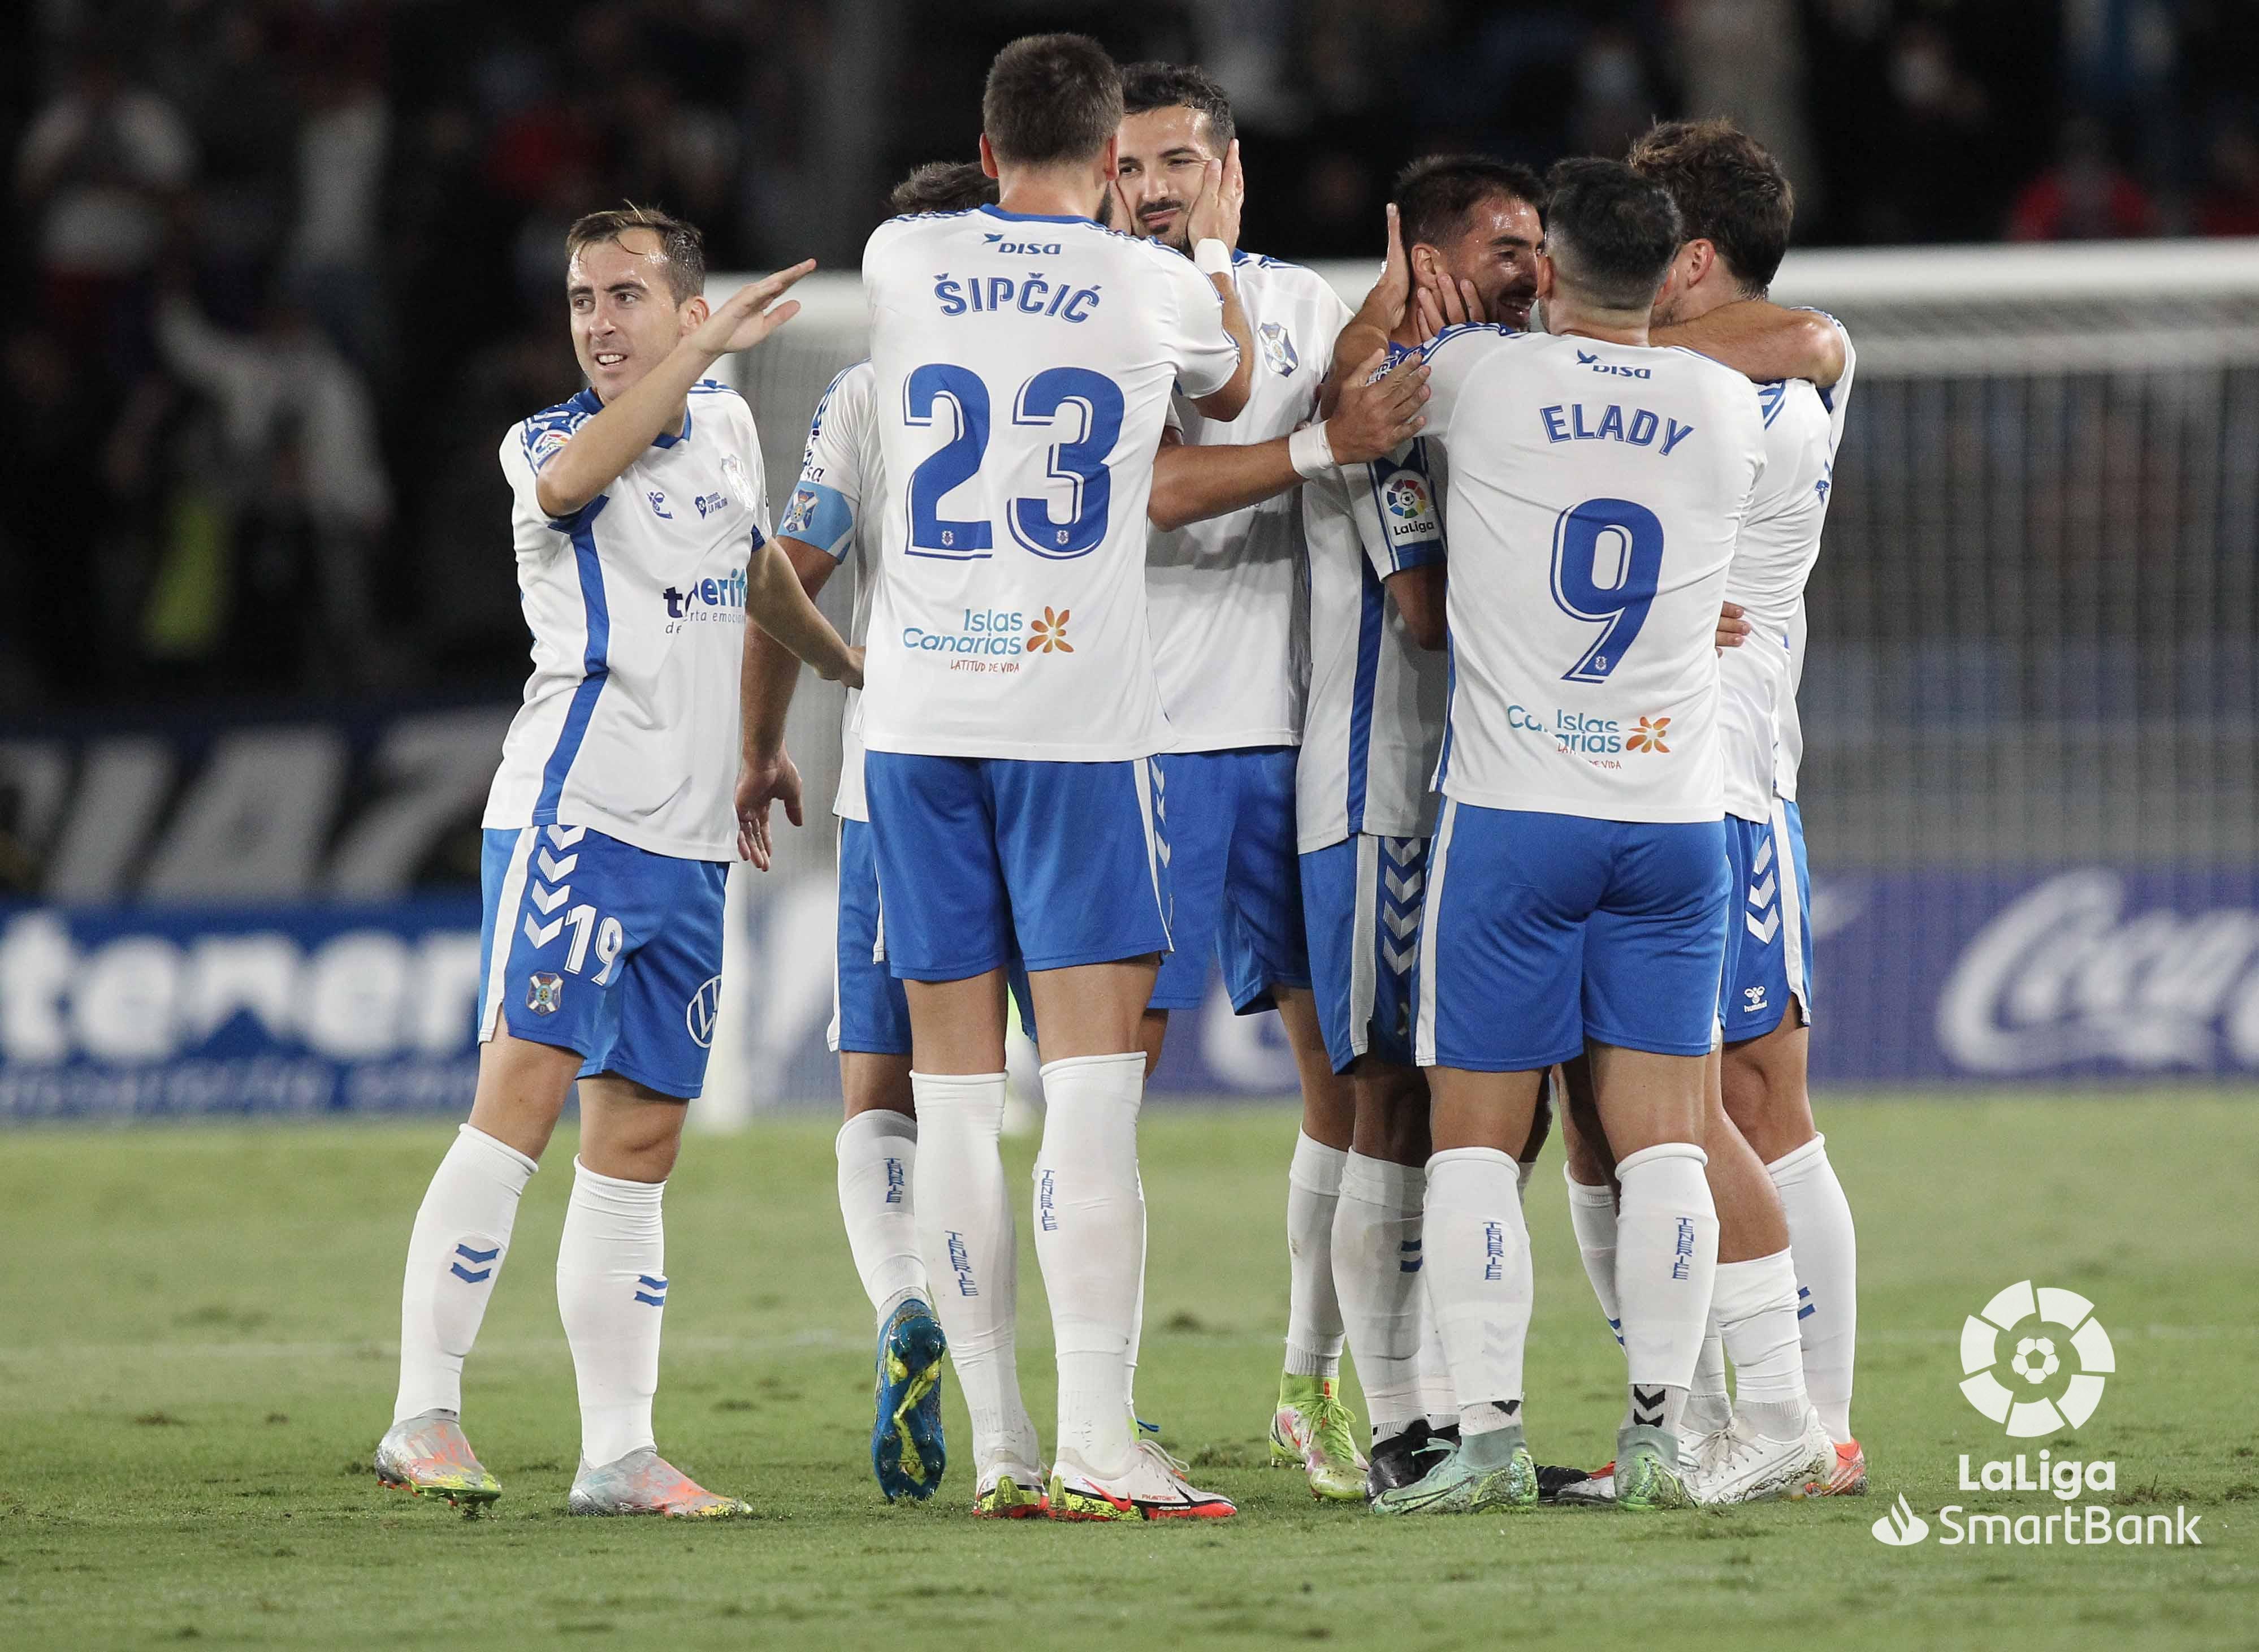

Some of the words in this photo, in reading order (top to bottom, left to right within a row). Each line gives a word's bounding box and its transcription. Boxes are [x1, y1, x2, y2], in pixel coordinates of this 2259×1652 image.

[933, 272, 1102, 323] ŠIPČIĆ
[1540, 404, 1694, 456] ELADY
[903, 363, 1124, 560] 23
[1394, 520, 1435, 537] LaLiga
[1550, 498, 1664, 684] 9
[903, 628, 1022, 655] Canarias
[963, 609, 1023, 632] Islas
[950, 659, 986, 672] LATITUD
[989, 663, 998, 672] DE
[1000, 662, 1019, 673] VIDA
[1557, 709, 1620, 734] Islas
[1601, 760, 1622, 769] VIDA
[564, 903, 622, 986] 19
[0, 909, 482, 1066] tener
[945, 1230, 979, 1296] TENERIFE
[1483, 1222, 1504, 1281] TENERIFE
[1672, 1217, 1694, 1280] TENERIFE
